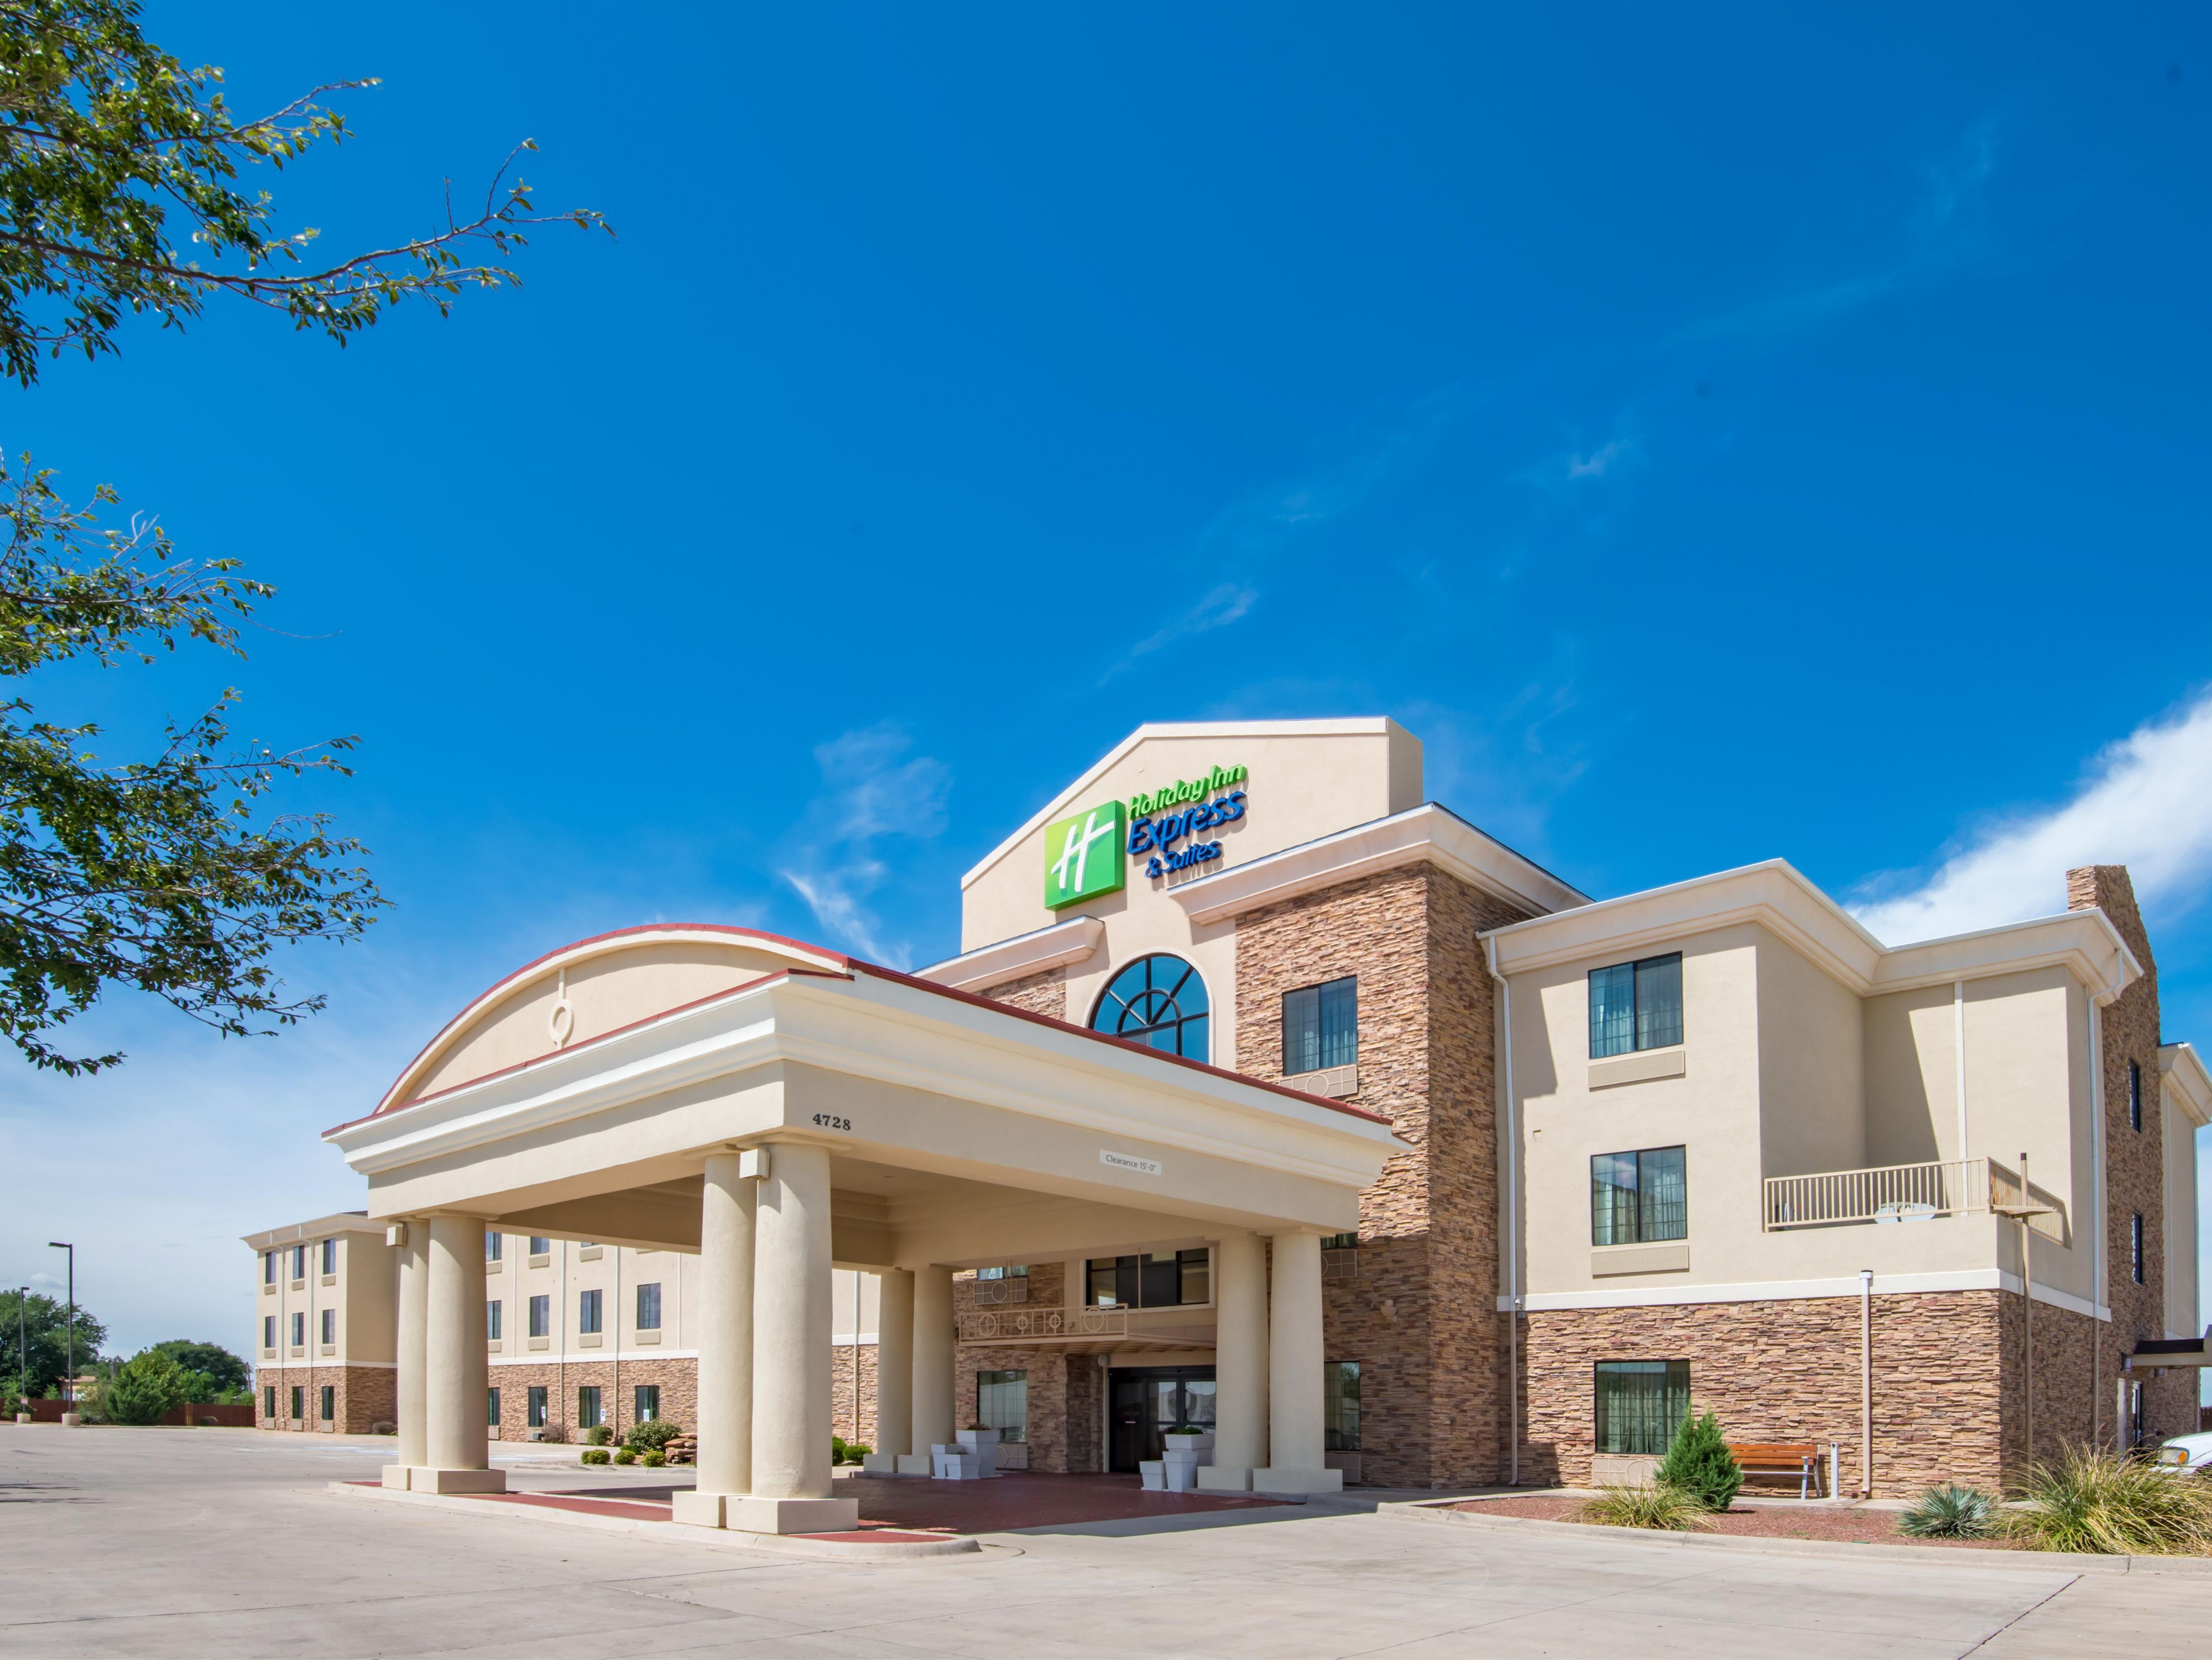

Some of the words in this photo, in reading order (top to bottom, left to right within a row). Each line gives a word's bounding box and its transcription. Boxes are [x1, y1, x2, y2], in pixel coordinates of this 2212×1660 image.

[1128, 777, 1209, 820] Holiday
[1208, 764, 1247, 791] Inn
[1127, 791, 1246, 855] Express
[1145, 857, 1161, 878] &
[1162, 841, 1222, 873] Suites
[812, 1113, 851, 1131] 4728
[1106, 1154, 1138, 1168] Clearance
